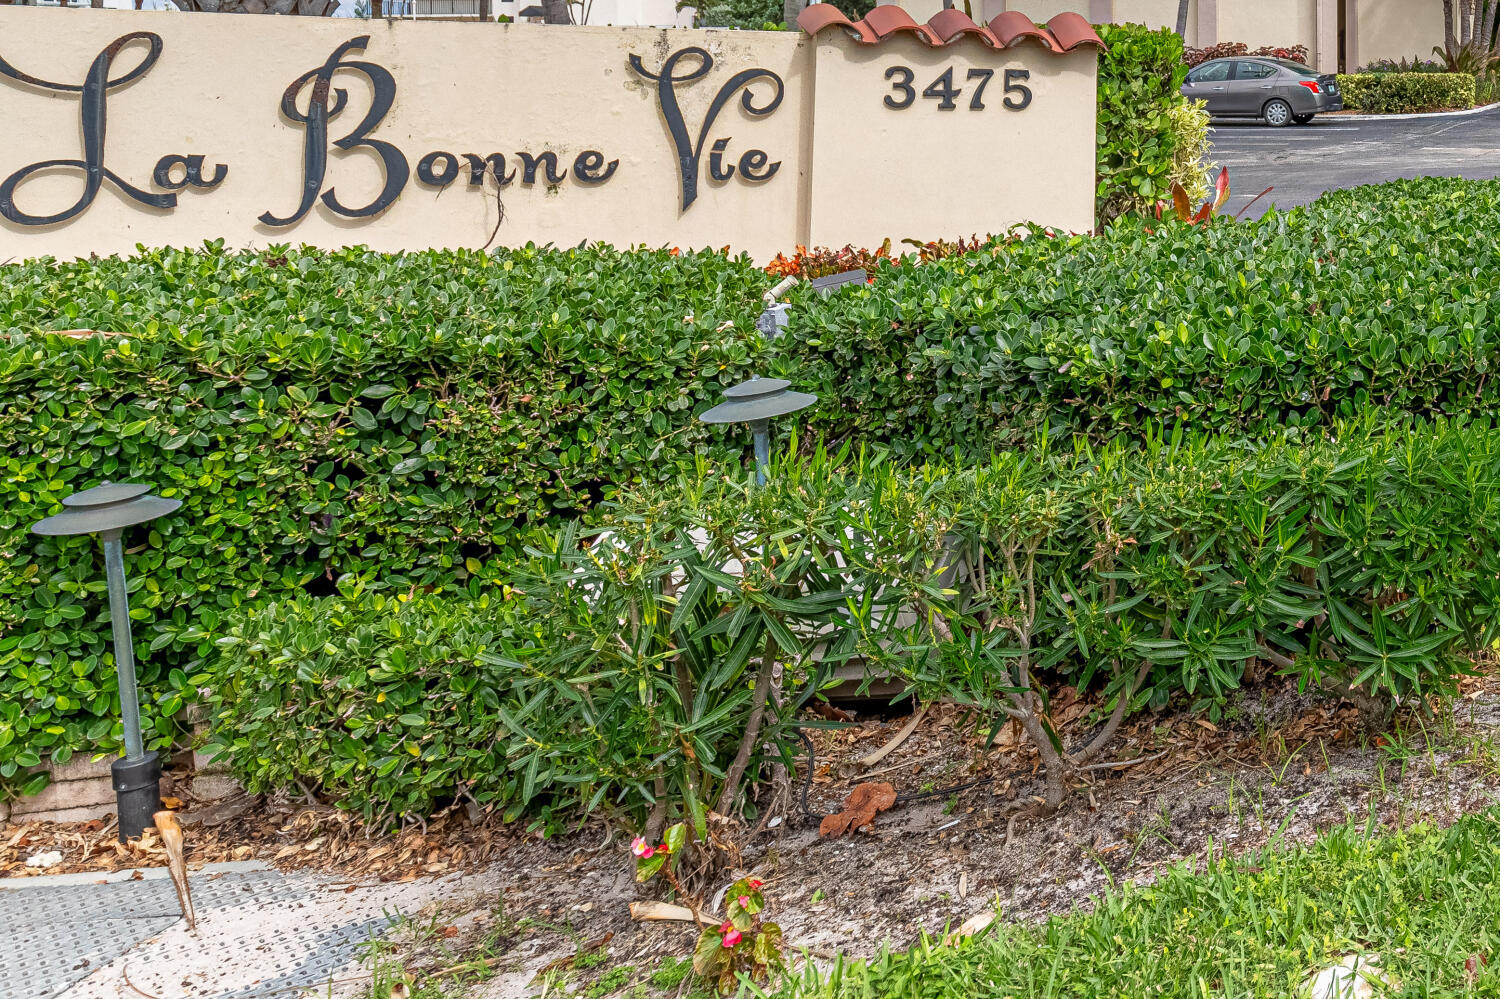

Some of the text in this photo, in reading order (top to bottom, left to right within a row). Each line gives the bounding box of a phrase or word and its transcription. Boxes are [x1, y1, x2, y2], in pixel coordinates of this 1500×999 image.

[0, 31, 785, 227] La Bonne Vie
[883, 65, 1033, 112] 3475
